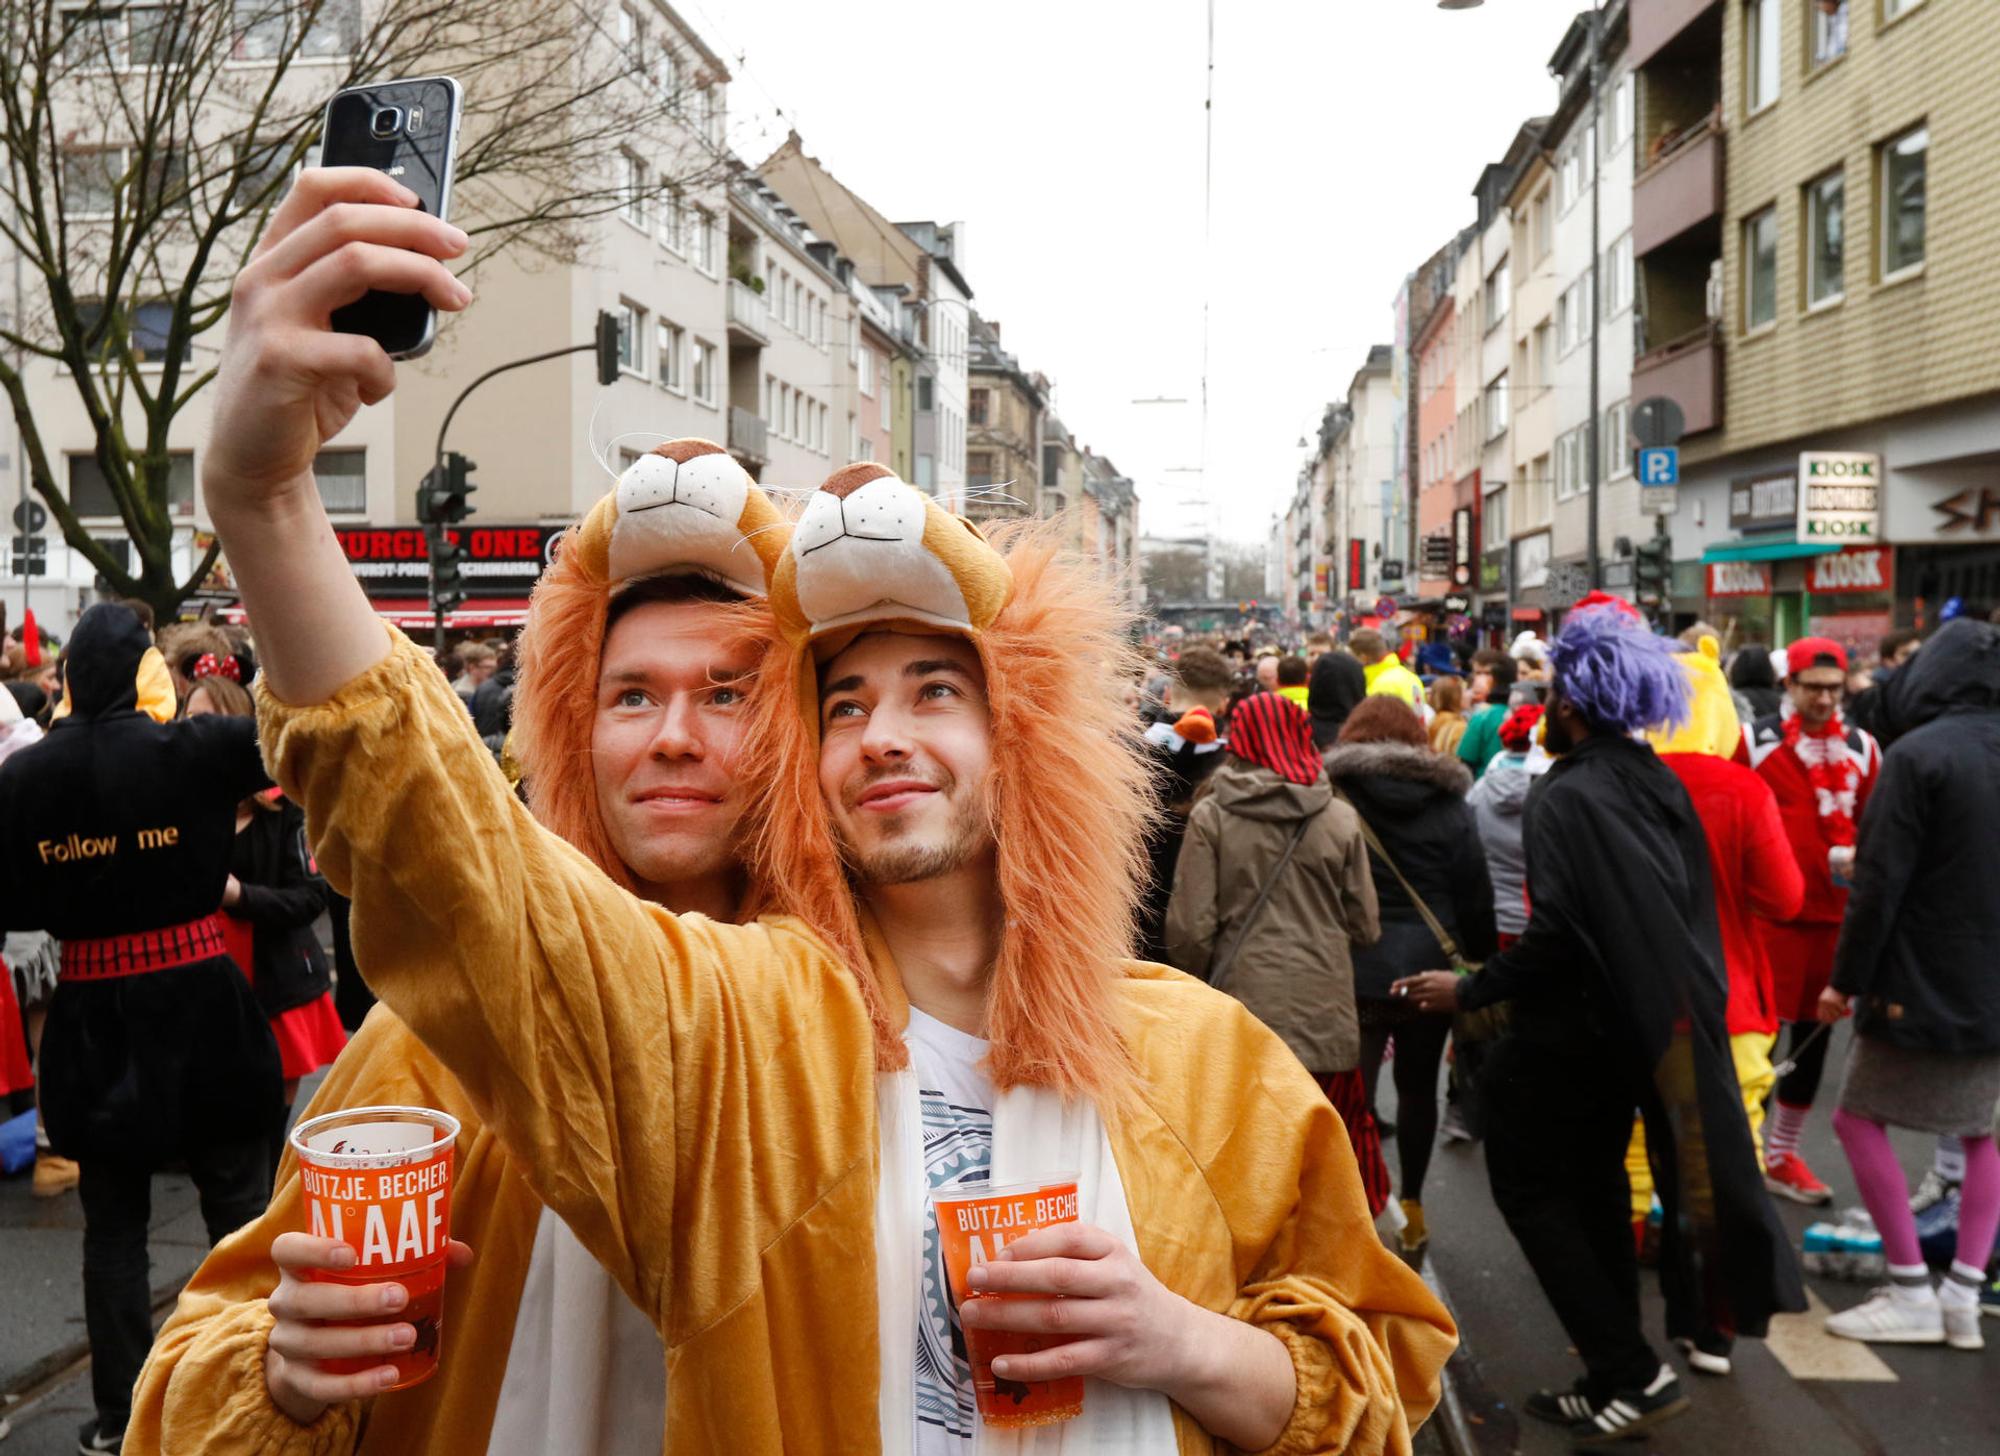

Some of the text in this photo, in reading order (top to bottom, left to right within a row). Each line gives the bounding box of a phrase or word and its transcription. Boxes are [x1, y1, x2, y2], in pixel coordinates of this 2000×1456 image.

[1810, 461, 1874, 477] KIOSK
[1808, 520, 1871, 535] KIOSK
[471, 530, 540, 558] ONE
[1814, 551, 1883, 589] KIOSK
[37, 826, 179, 864] Follow me
[303, 1161, 449, 1200] BÜTZJE. BECHER.
[957, 1202, 1032, 1231] BÜTZJE.
